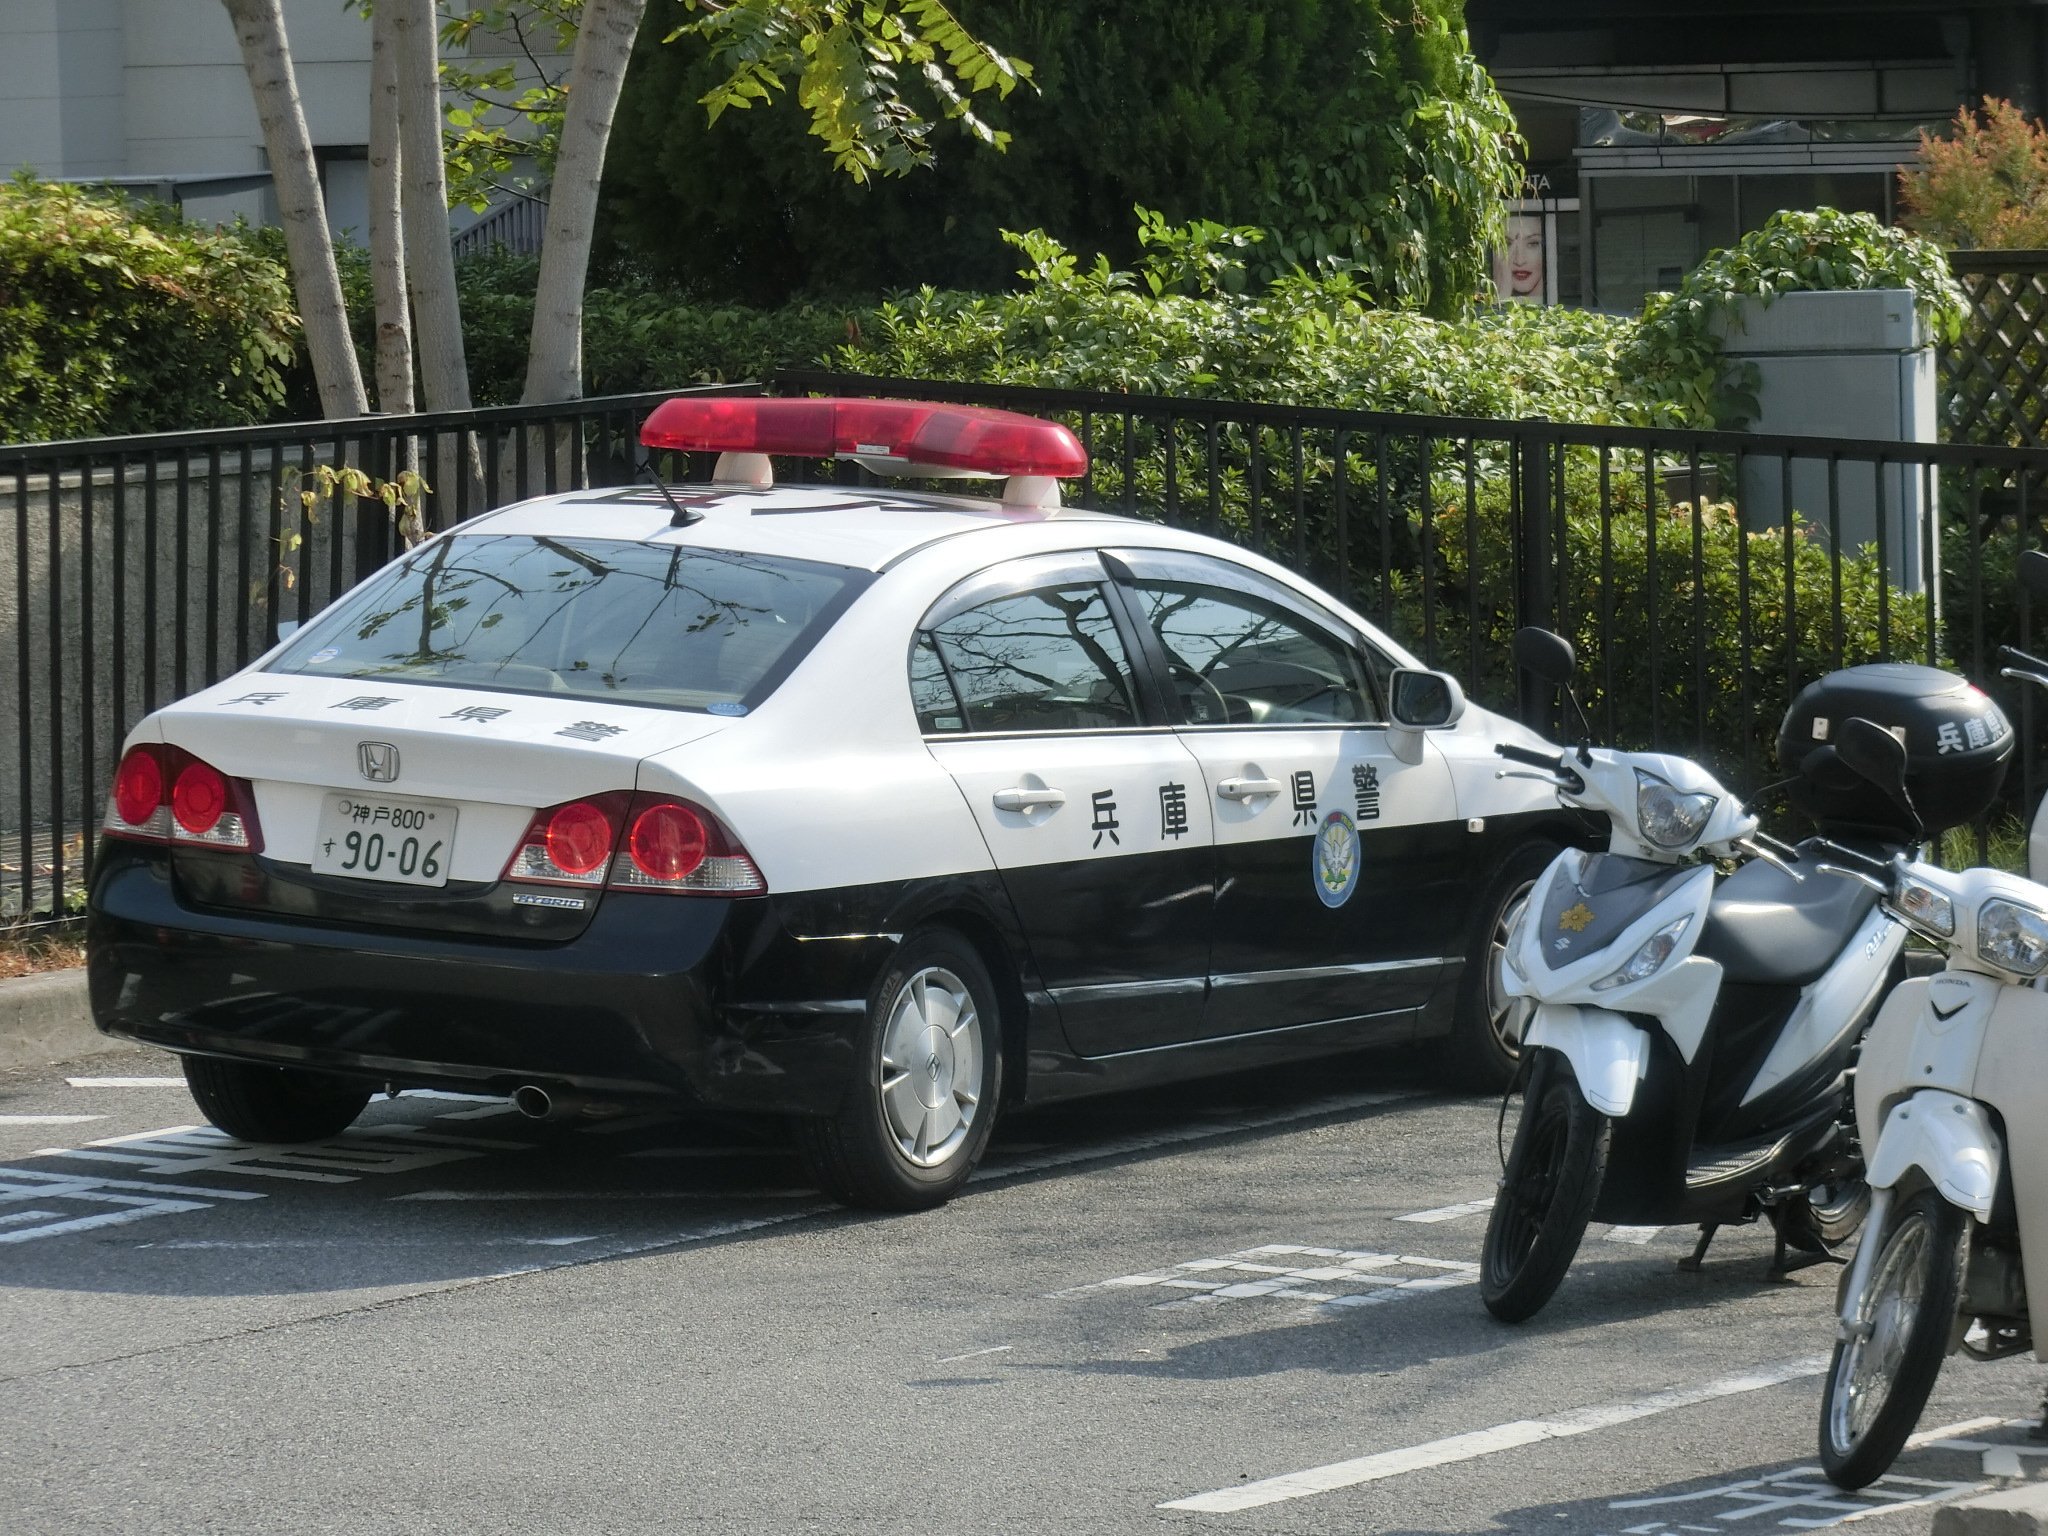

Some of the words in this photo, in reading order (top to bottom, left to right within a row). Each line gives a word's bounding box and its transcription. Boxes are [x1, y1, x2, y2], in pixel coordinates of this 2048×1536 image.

[1091, 763, 1380, 850] 兵庫県警
[341, 830, 442, 878] 90-06
[1935, 979, 1971, 988] HONDA
